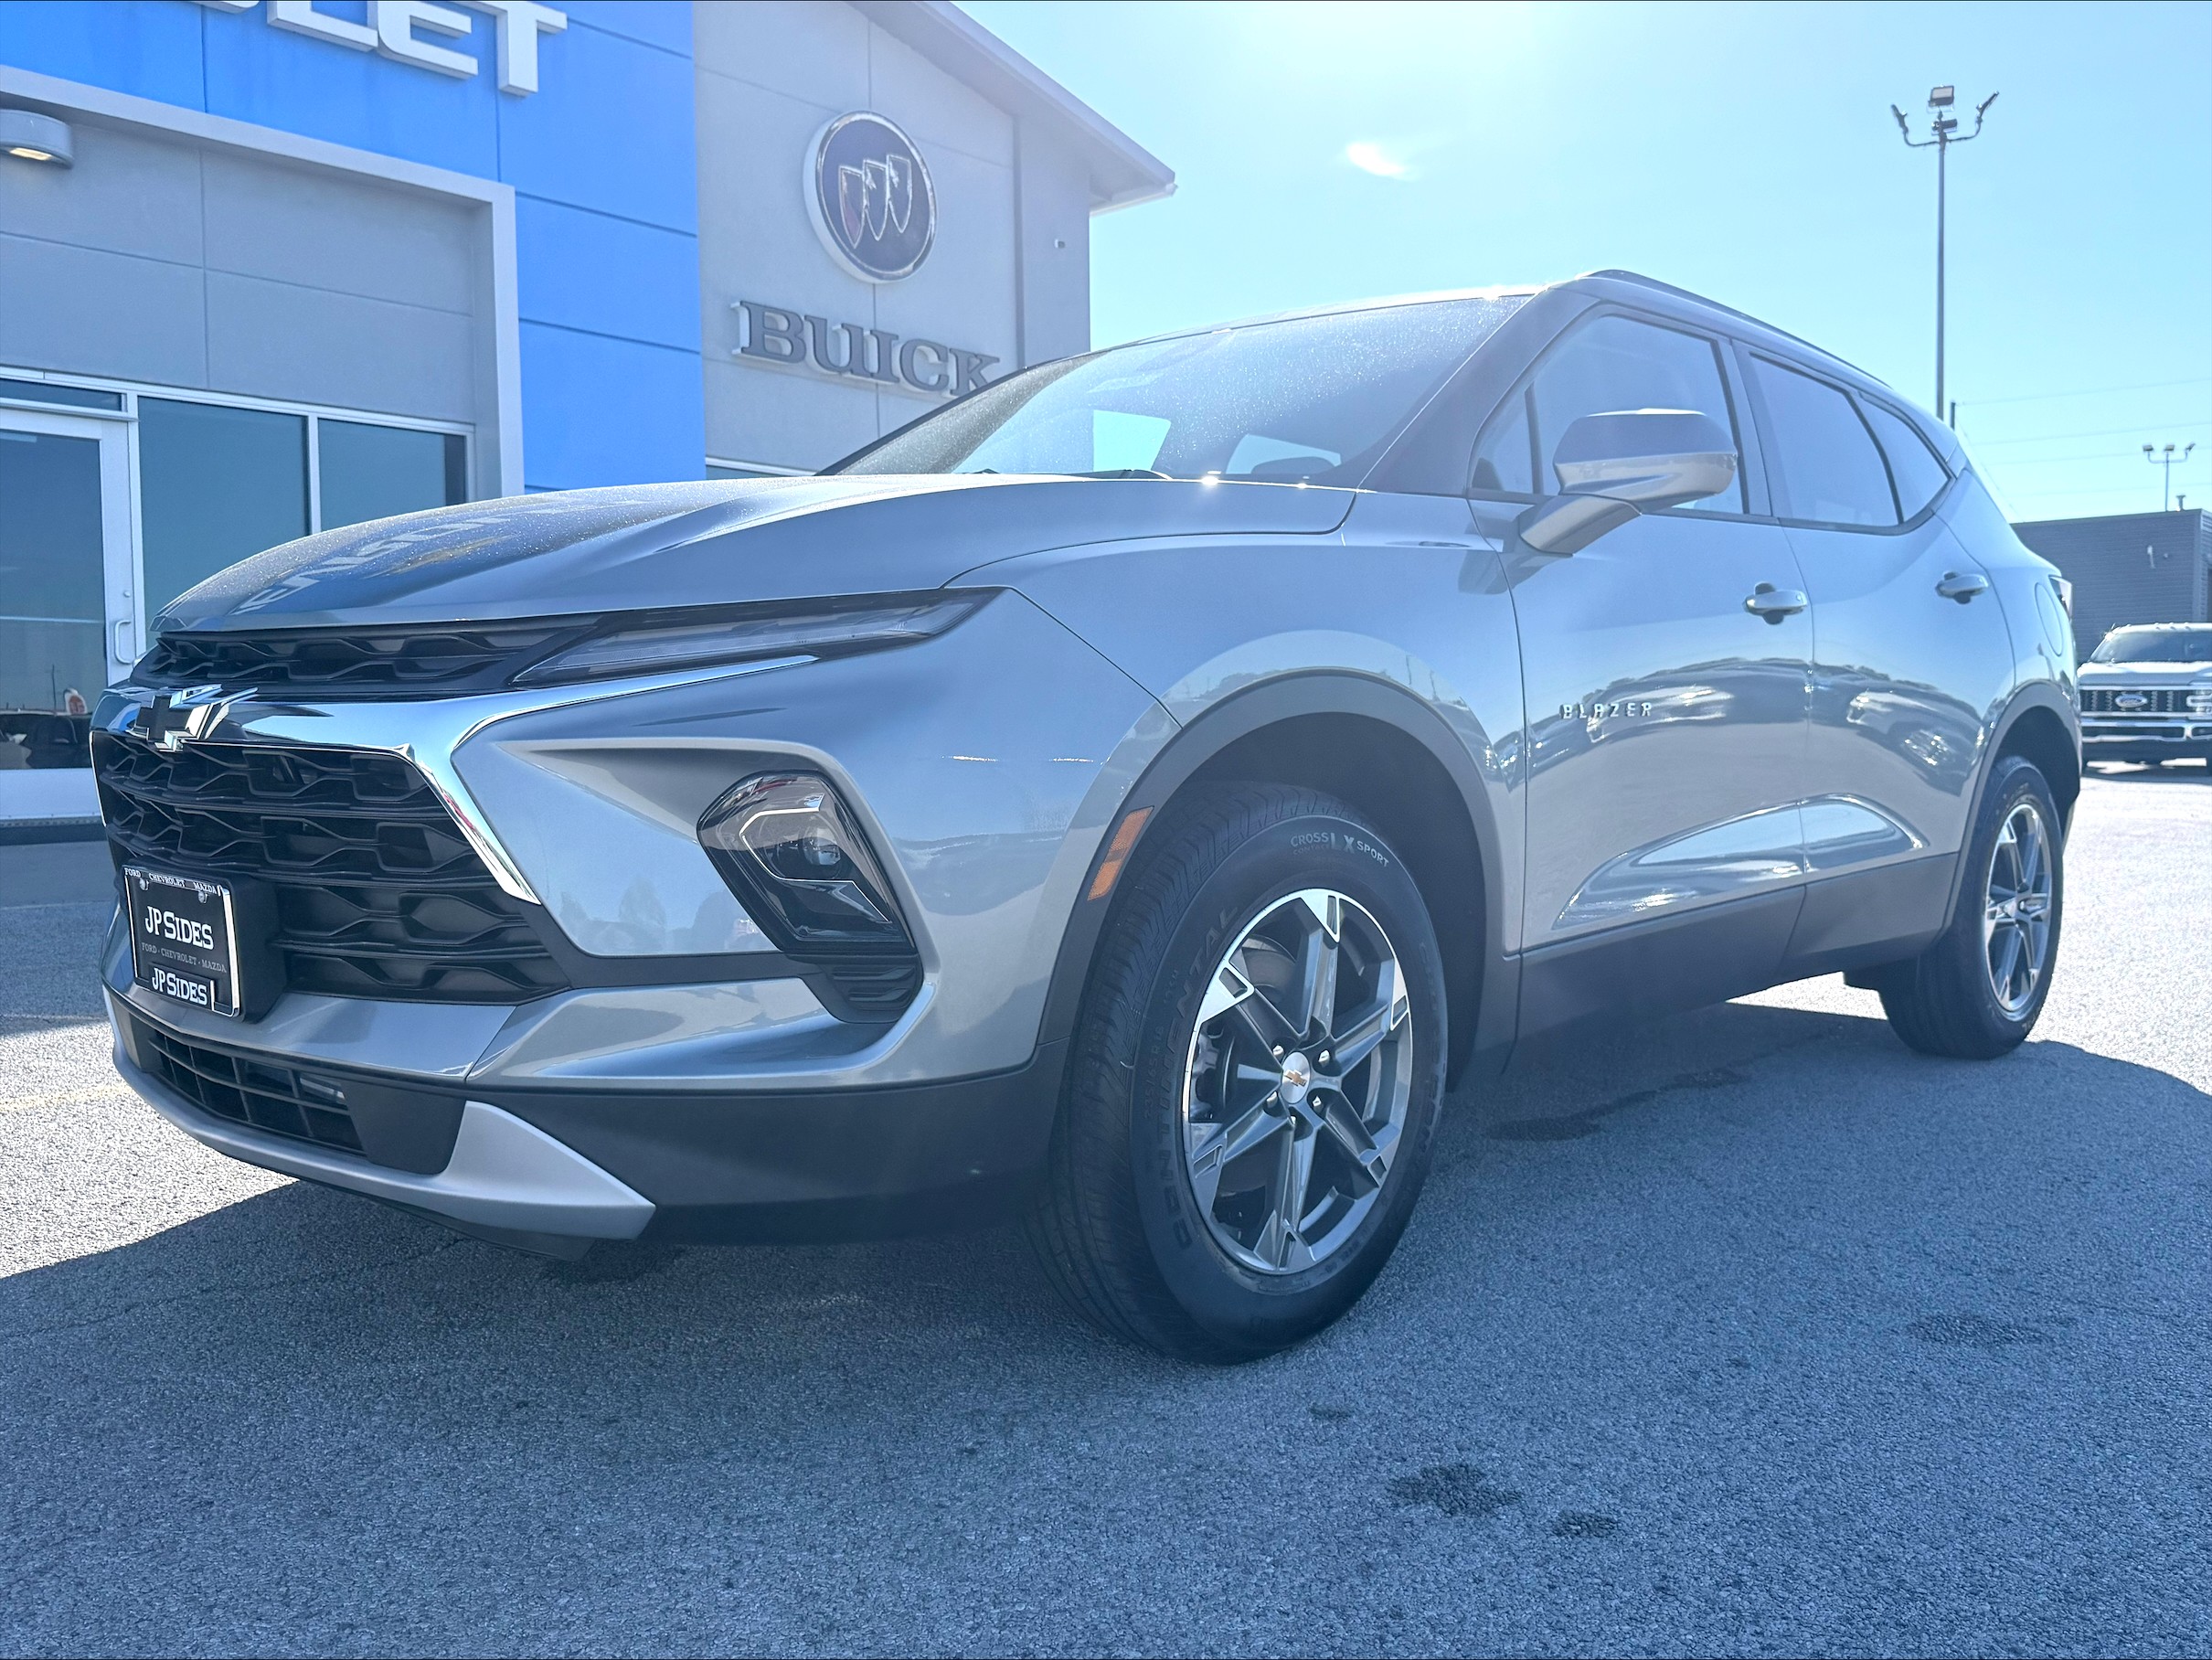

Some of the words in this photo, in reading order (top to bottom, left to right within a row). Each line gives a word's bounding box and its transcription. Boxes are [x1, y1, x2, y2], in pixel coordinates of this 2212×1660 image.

[186, 0, 568, 97] LET
[732, 300, 1001, 398] BUICK
[1559, 702, 1652, 719] BLAZER
[1290, 832, 1329, 847] CROSS
[1356, 840, 1389, 867] SPORT
[124, 867, 141, 878] FORD
[148, 873, 186, 888] CHEVROLET
[193, 881, 217, 894] MAZDA
[144, 906, 163, 935] JP
[164, 911, 214, 950] SIDES
[141, 942, 157, 953] FORD
[161, 948, 197, 965] CHEVROLET
[201, 959, 227, 973] MAZDA
[152, 967, 166, 992] JP
[166, 973, 207, 1006] SIDES
[1157, 905, 1239, 1250] CONTINENTAL
